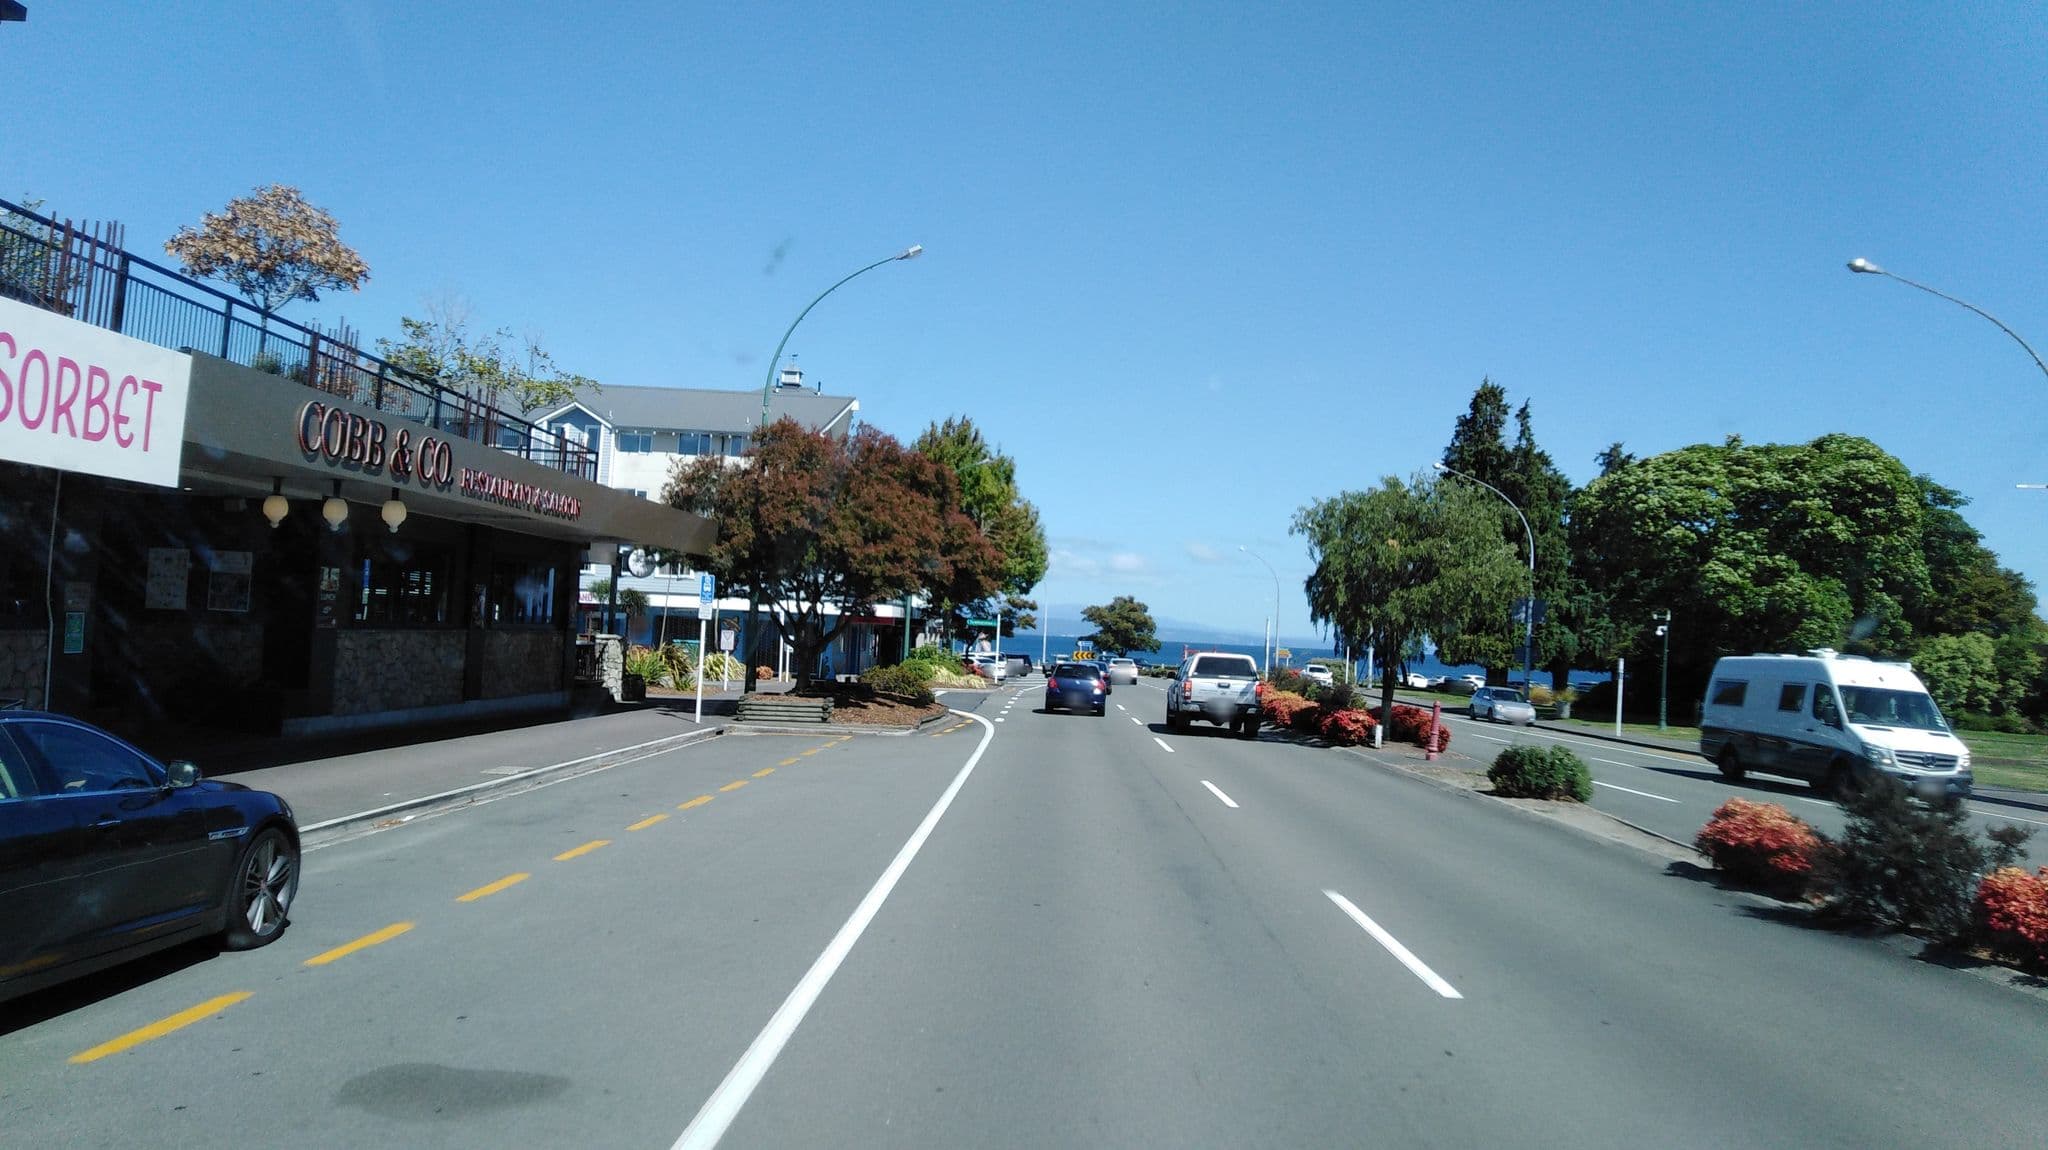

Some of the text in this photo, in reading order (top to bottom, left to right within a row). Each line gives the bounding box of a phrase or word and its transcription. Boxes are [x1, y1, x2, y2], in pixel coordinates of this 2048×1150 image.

[0, 331, 163, 452] SORBET
[298, 400, 454, 485] COBB & CO.
